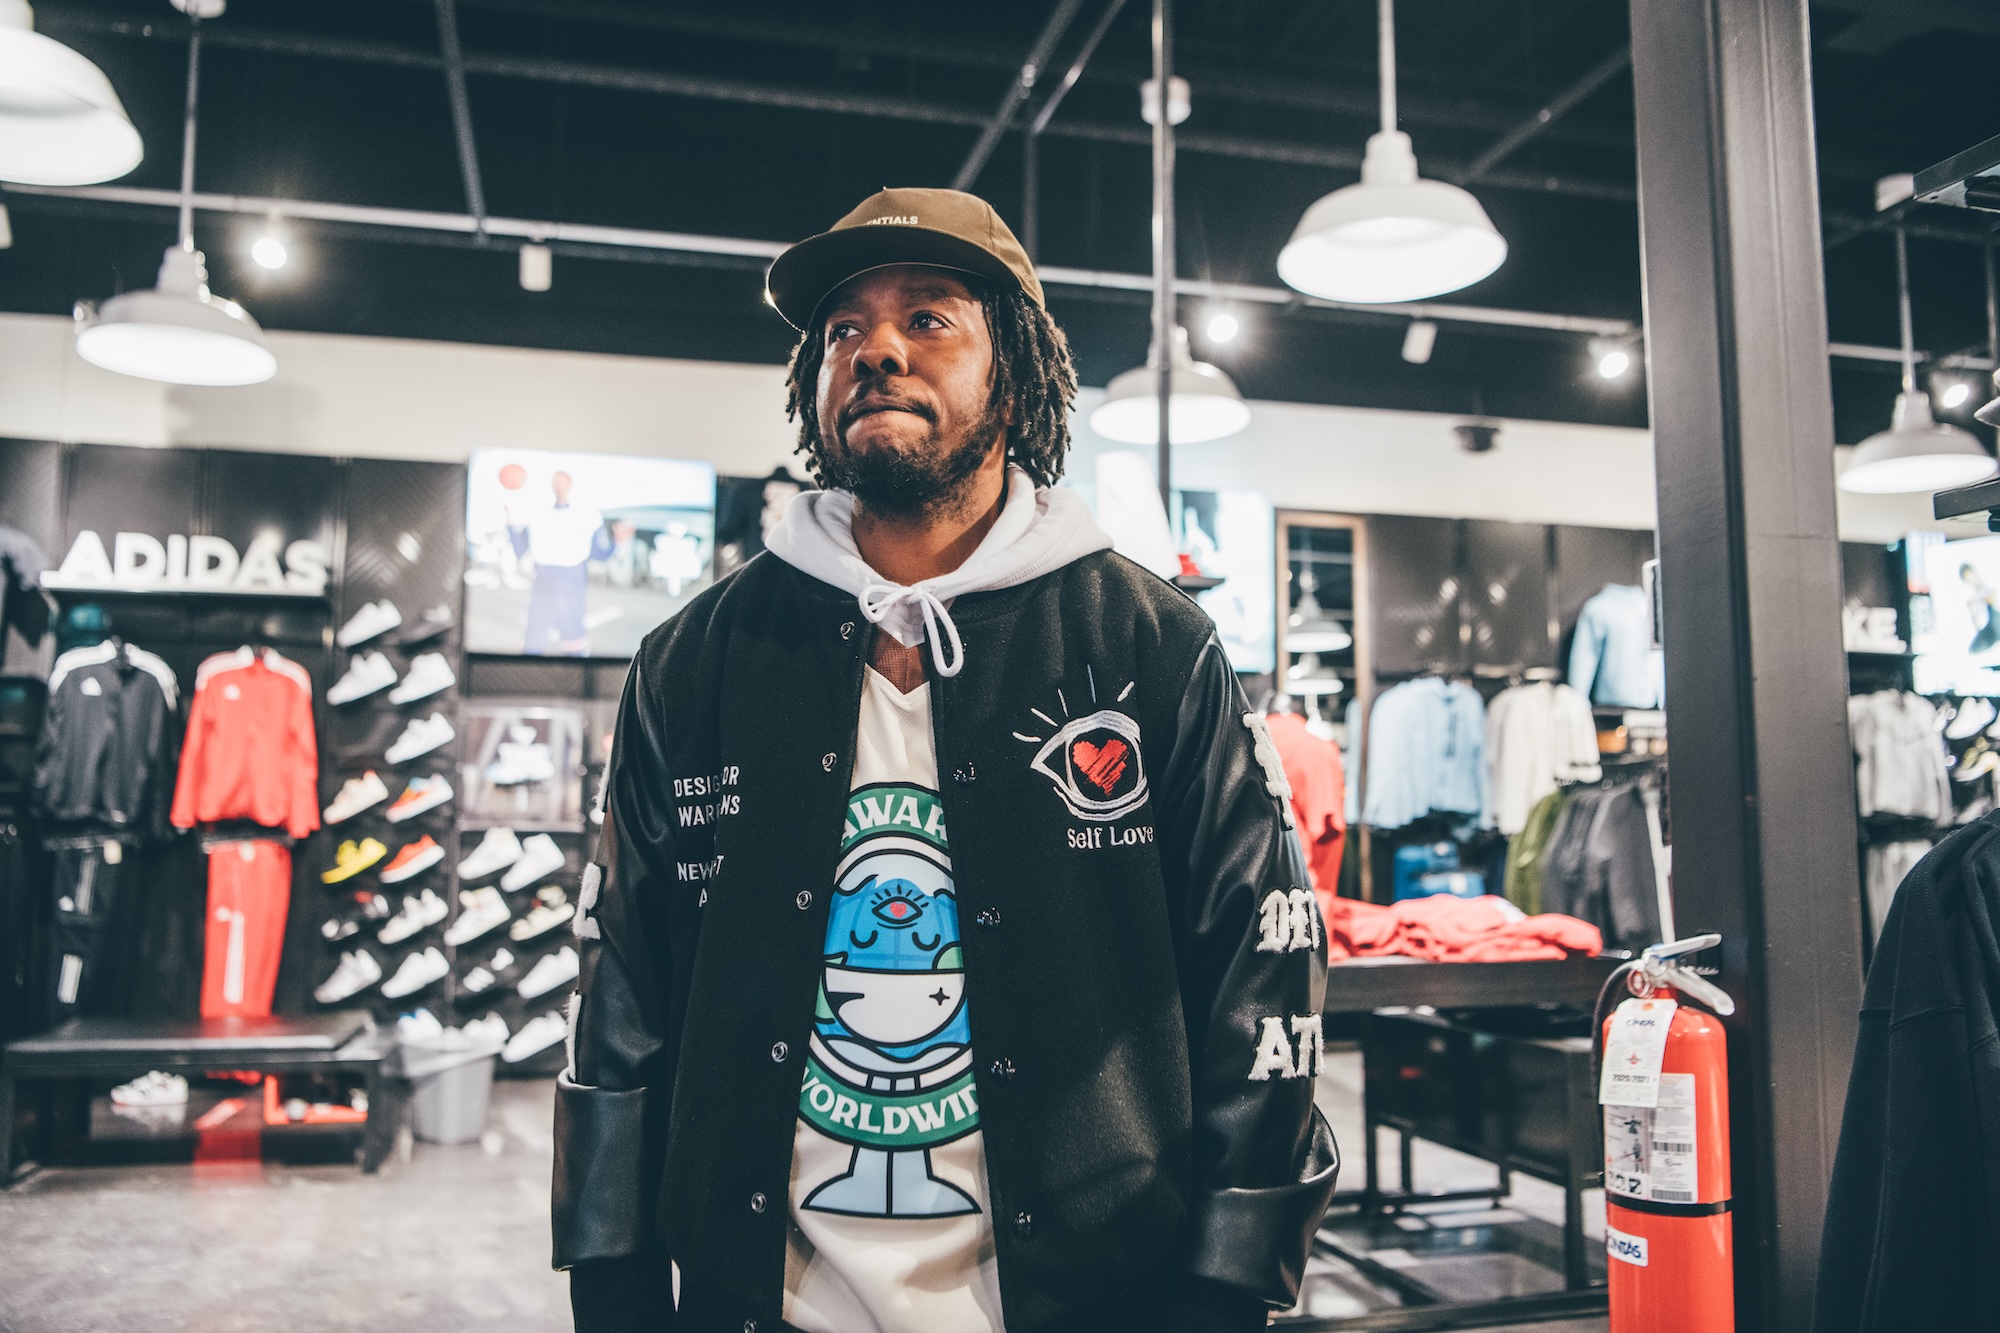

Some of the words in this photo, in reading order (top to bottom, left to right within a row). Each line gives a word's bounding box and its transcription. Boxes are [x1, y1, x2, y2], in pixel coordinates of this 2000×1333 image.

[57, 530, 329, 594] ADIDAS
[1067, 827, 1103, 849] Self
[1109, 826, 1153, 846] Love
